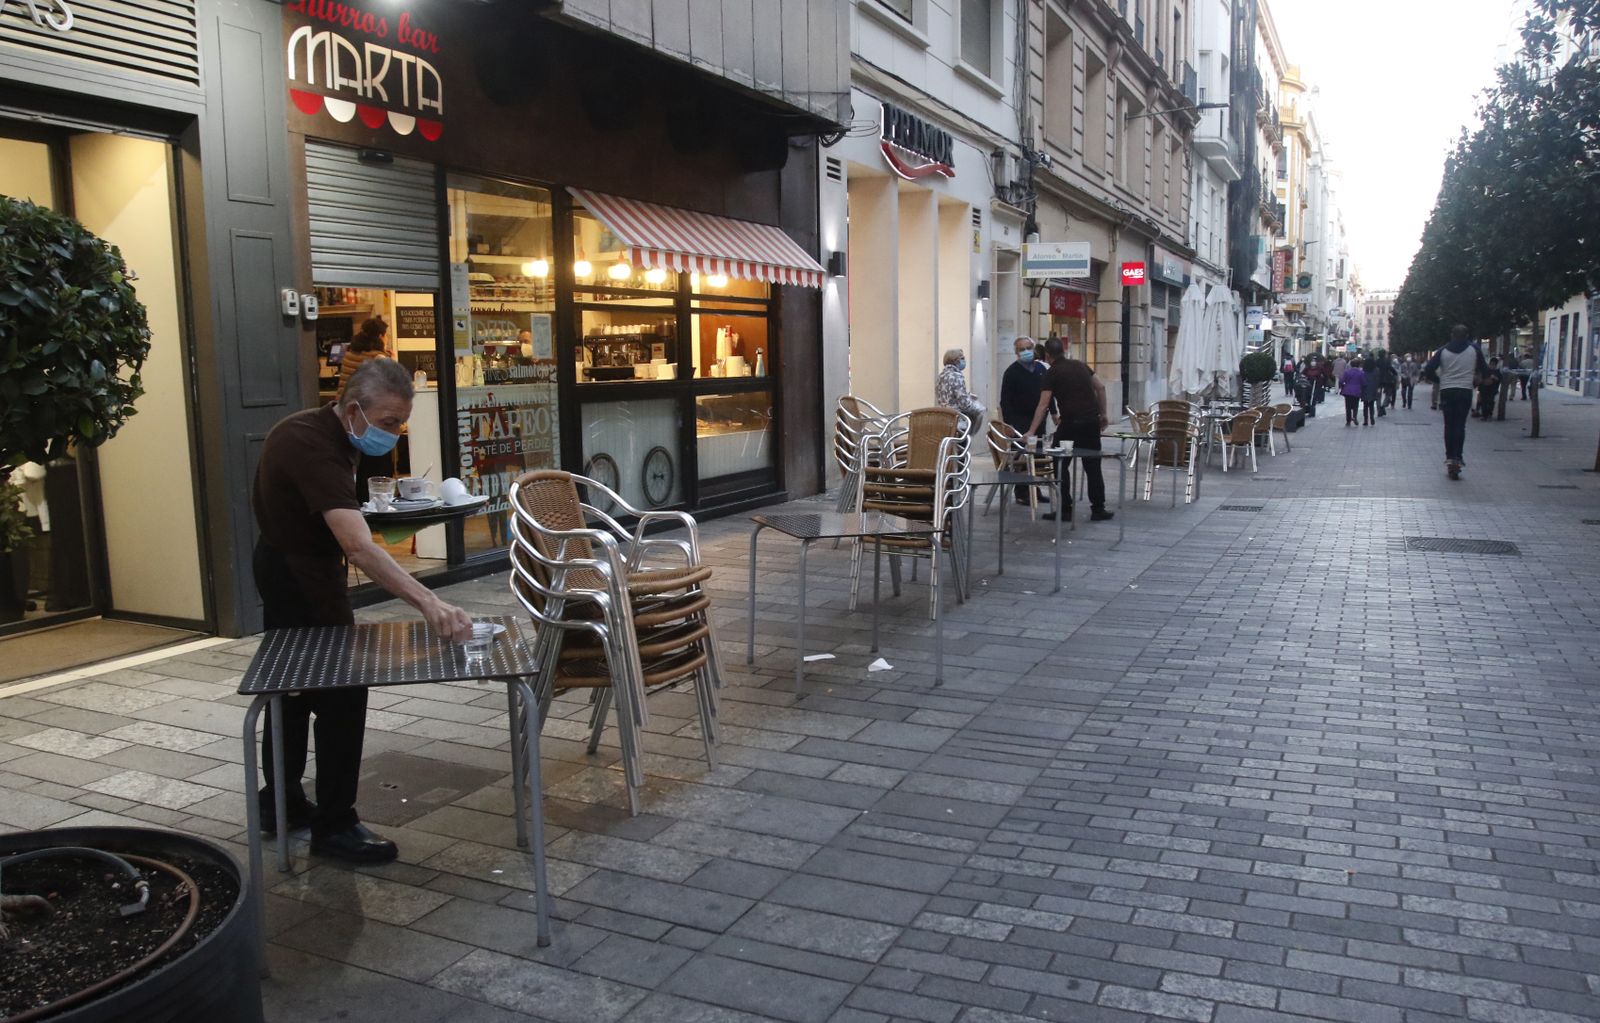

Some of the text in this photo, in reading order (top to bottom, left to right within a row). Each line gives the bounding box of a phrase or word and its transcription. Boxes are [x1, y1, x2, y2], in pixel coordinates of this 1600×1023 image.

[396, 11, 440, 53] bar
[287, 25, 443, 115] MARTA
[880, 103, 955, 168] PRIMOR
[1122, 268, 1144, 277] GAES
[509, 363, 550, 380] salmorejo
[471, 406, 551, 442] TAPEO
[473, 437, 551, 457] PATÉ DE PERDIZ
